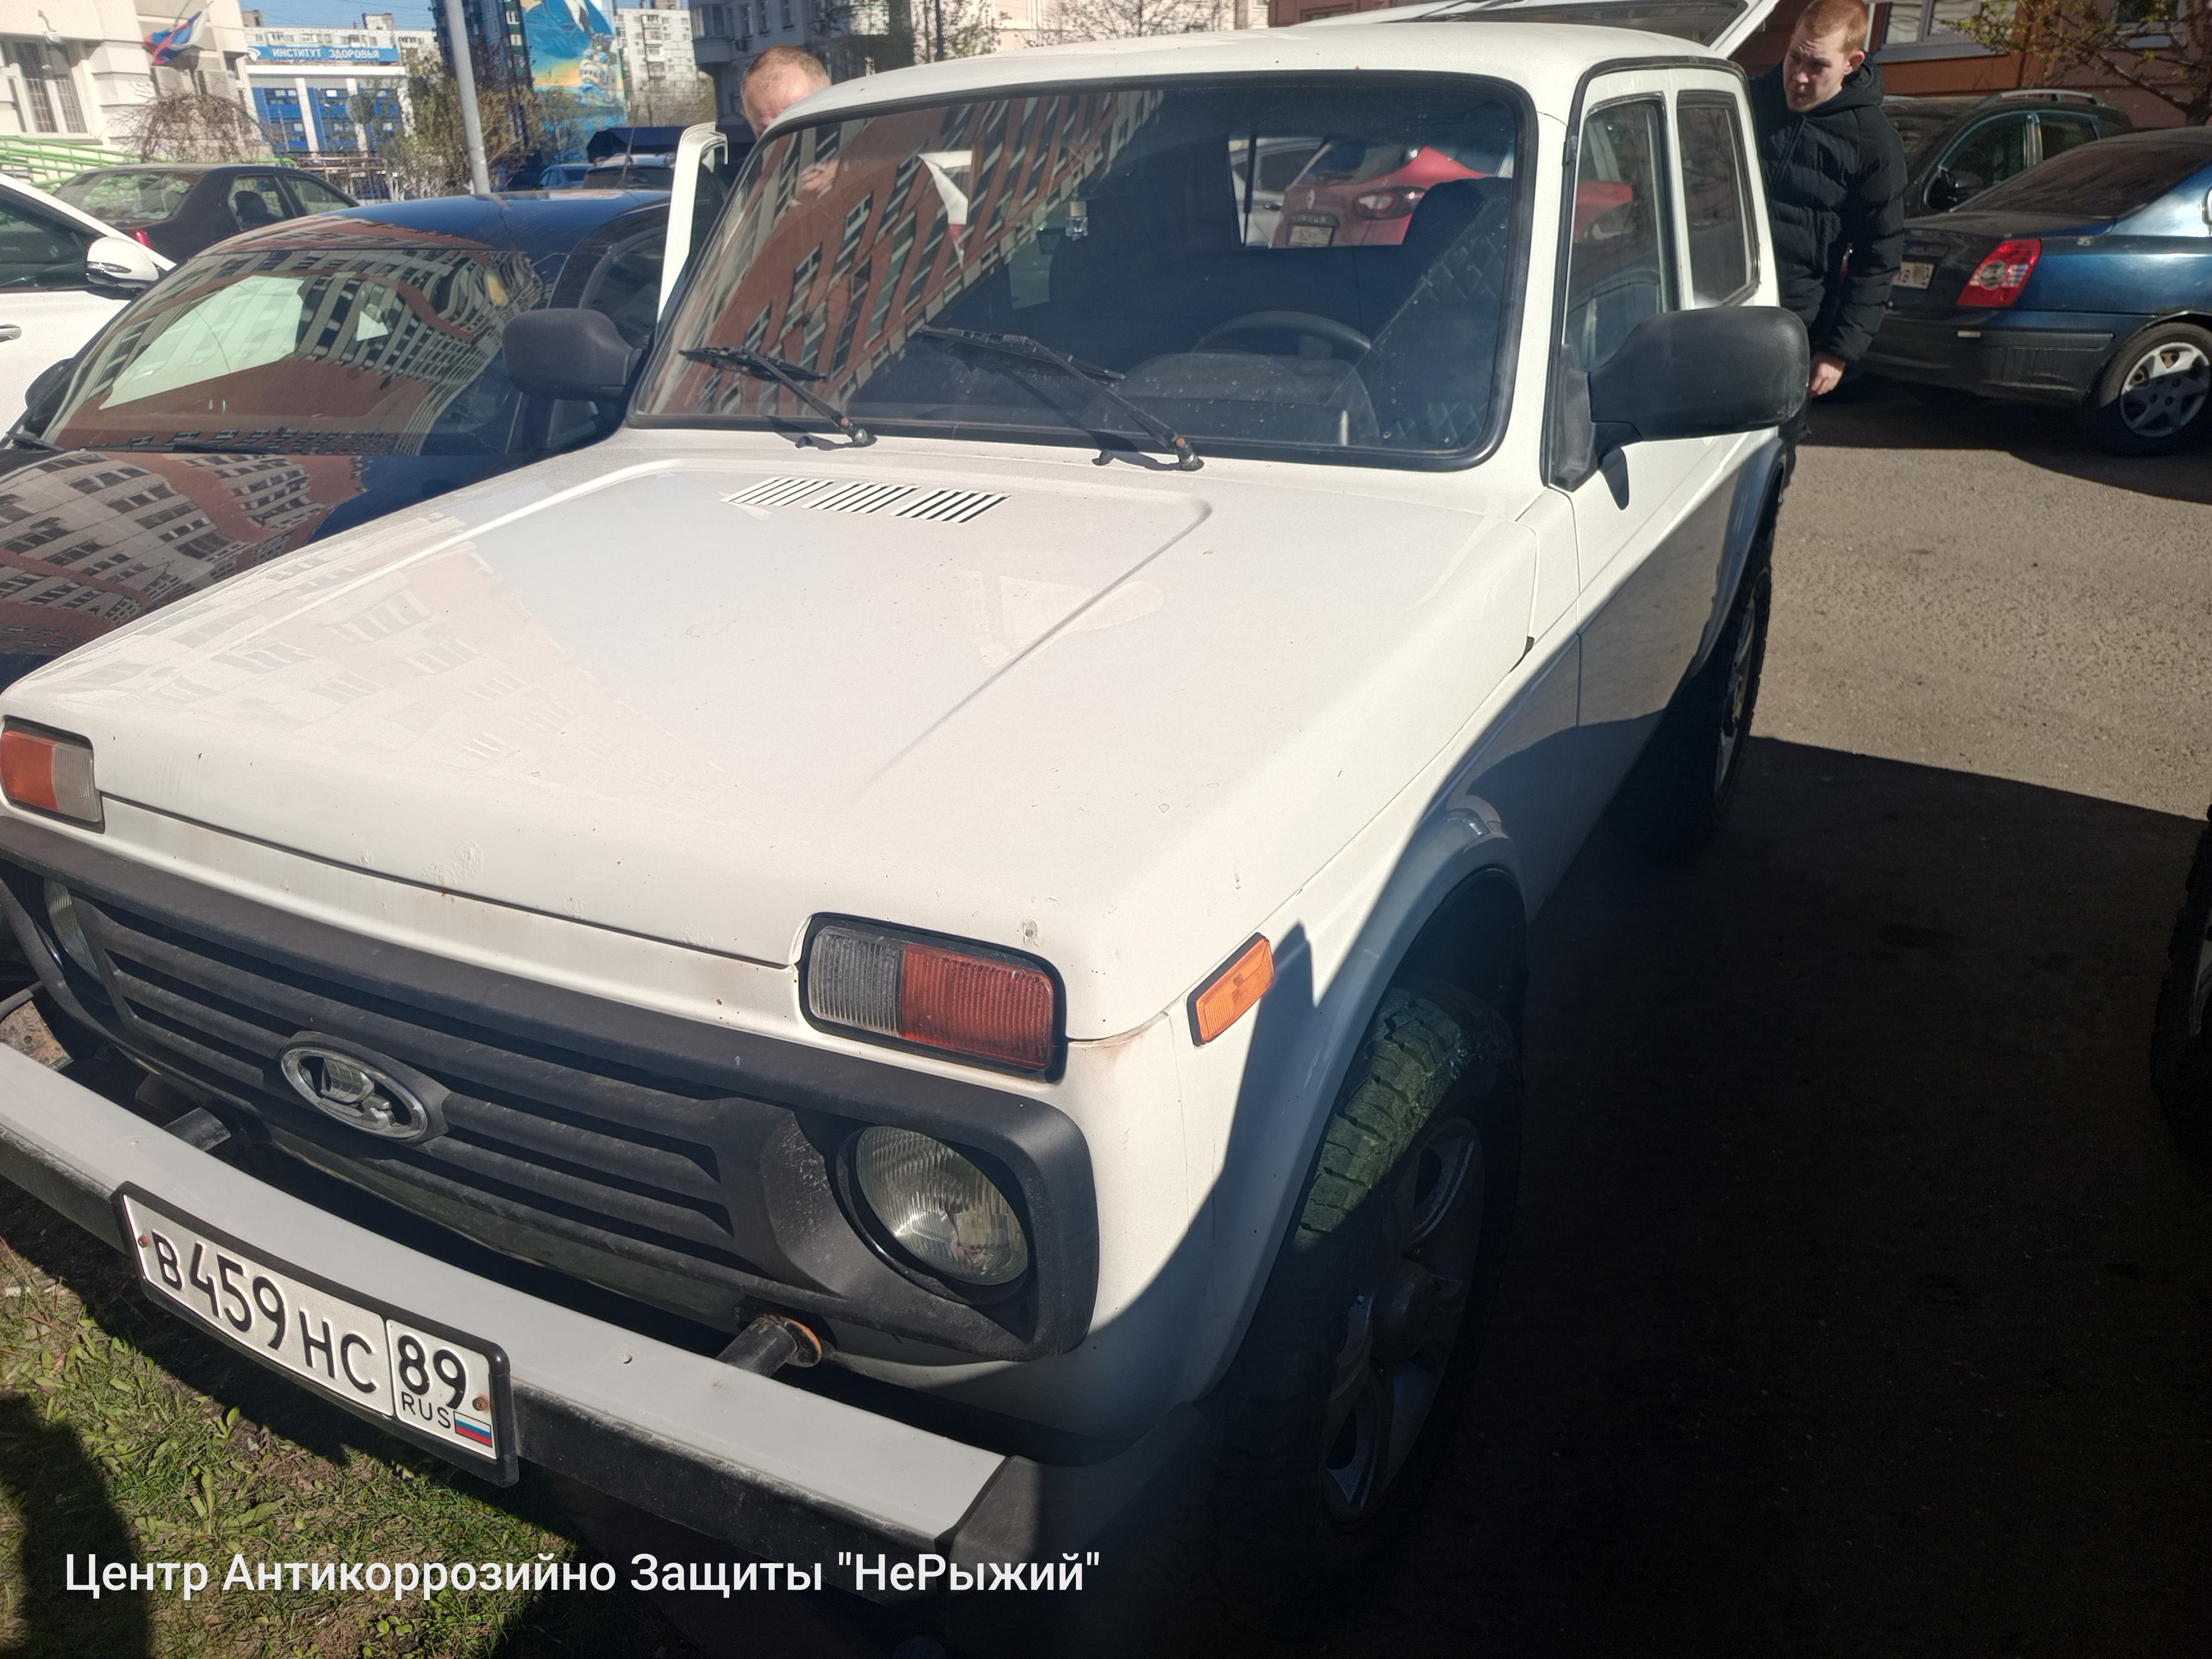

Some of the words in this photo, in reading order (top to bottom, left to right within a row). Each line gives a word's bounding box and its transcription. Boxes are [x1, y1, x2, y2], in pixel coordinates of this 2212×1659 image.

[271, 47, 322, 59] ИНСТИТУТ
[328, 48, 380, 60] ЗДОРОВЬЯ
[397, 1334, 469, 1410] 89
[401, 1391, 452, 1430] RUS
